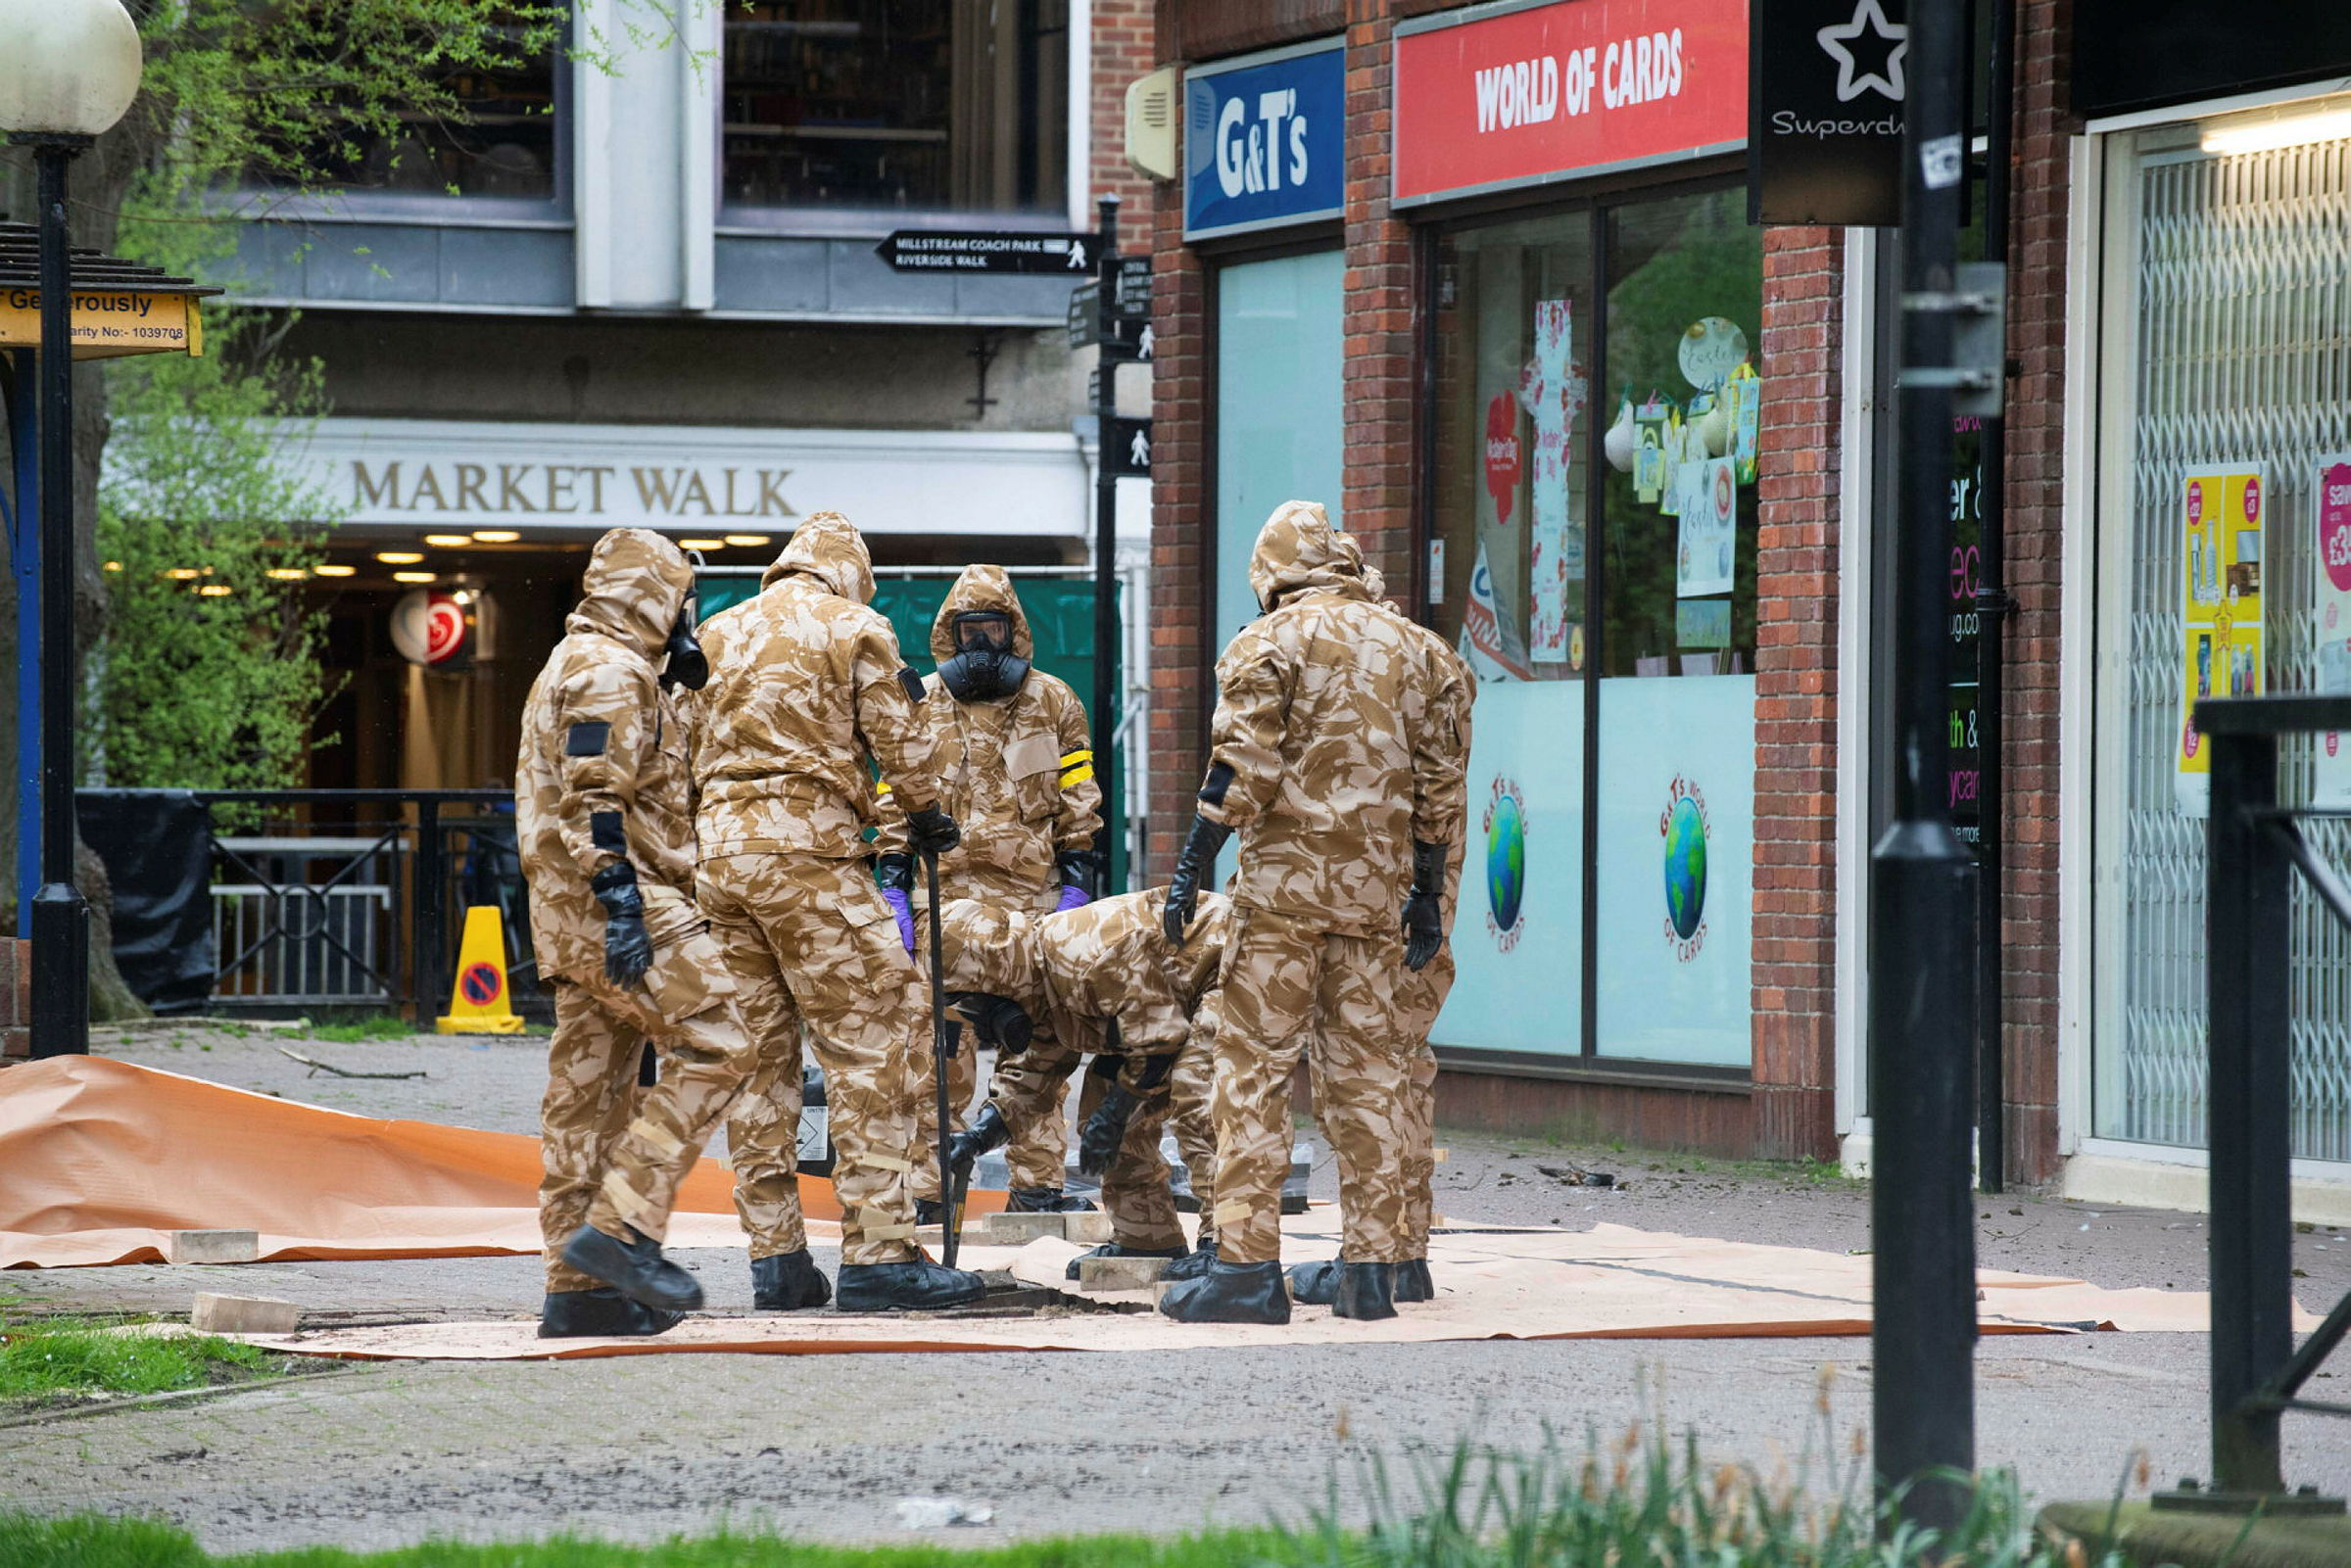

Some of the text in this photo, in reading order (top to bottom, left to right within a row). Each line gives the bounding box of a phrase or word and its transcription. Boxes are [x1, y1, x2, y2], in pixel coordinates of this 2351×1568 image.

[1474, 27, 1683, 133] WORLD OF CARDS
[1216, 87, 1309, 199] G&T's
[895, 238, 1042, 253] MILLSTREAM COACH PARK
[895, 255, 988, 266] RIVERSIDE WALK
[71, 326, 98, 339] arity
[133, 327, 184, 339] 1039708
[351, 460, 799, 517] MARKET WALK
[1689, 779, 1711, 839] WORLD
[1677, 918, 1708, 963] CARDS
